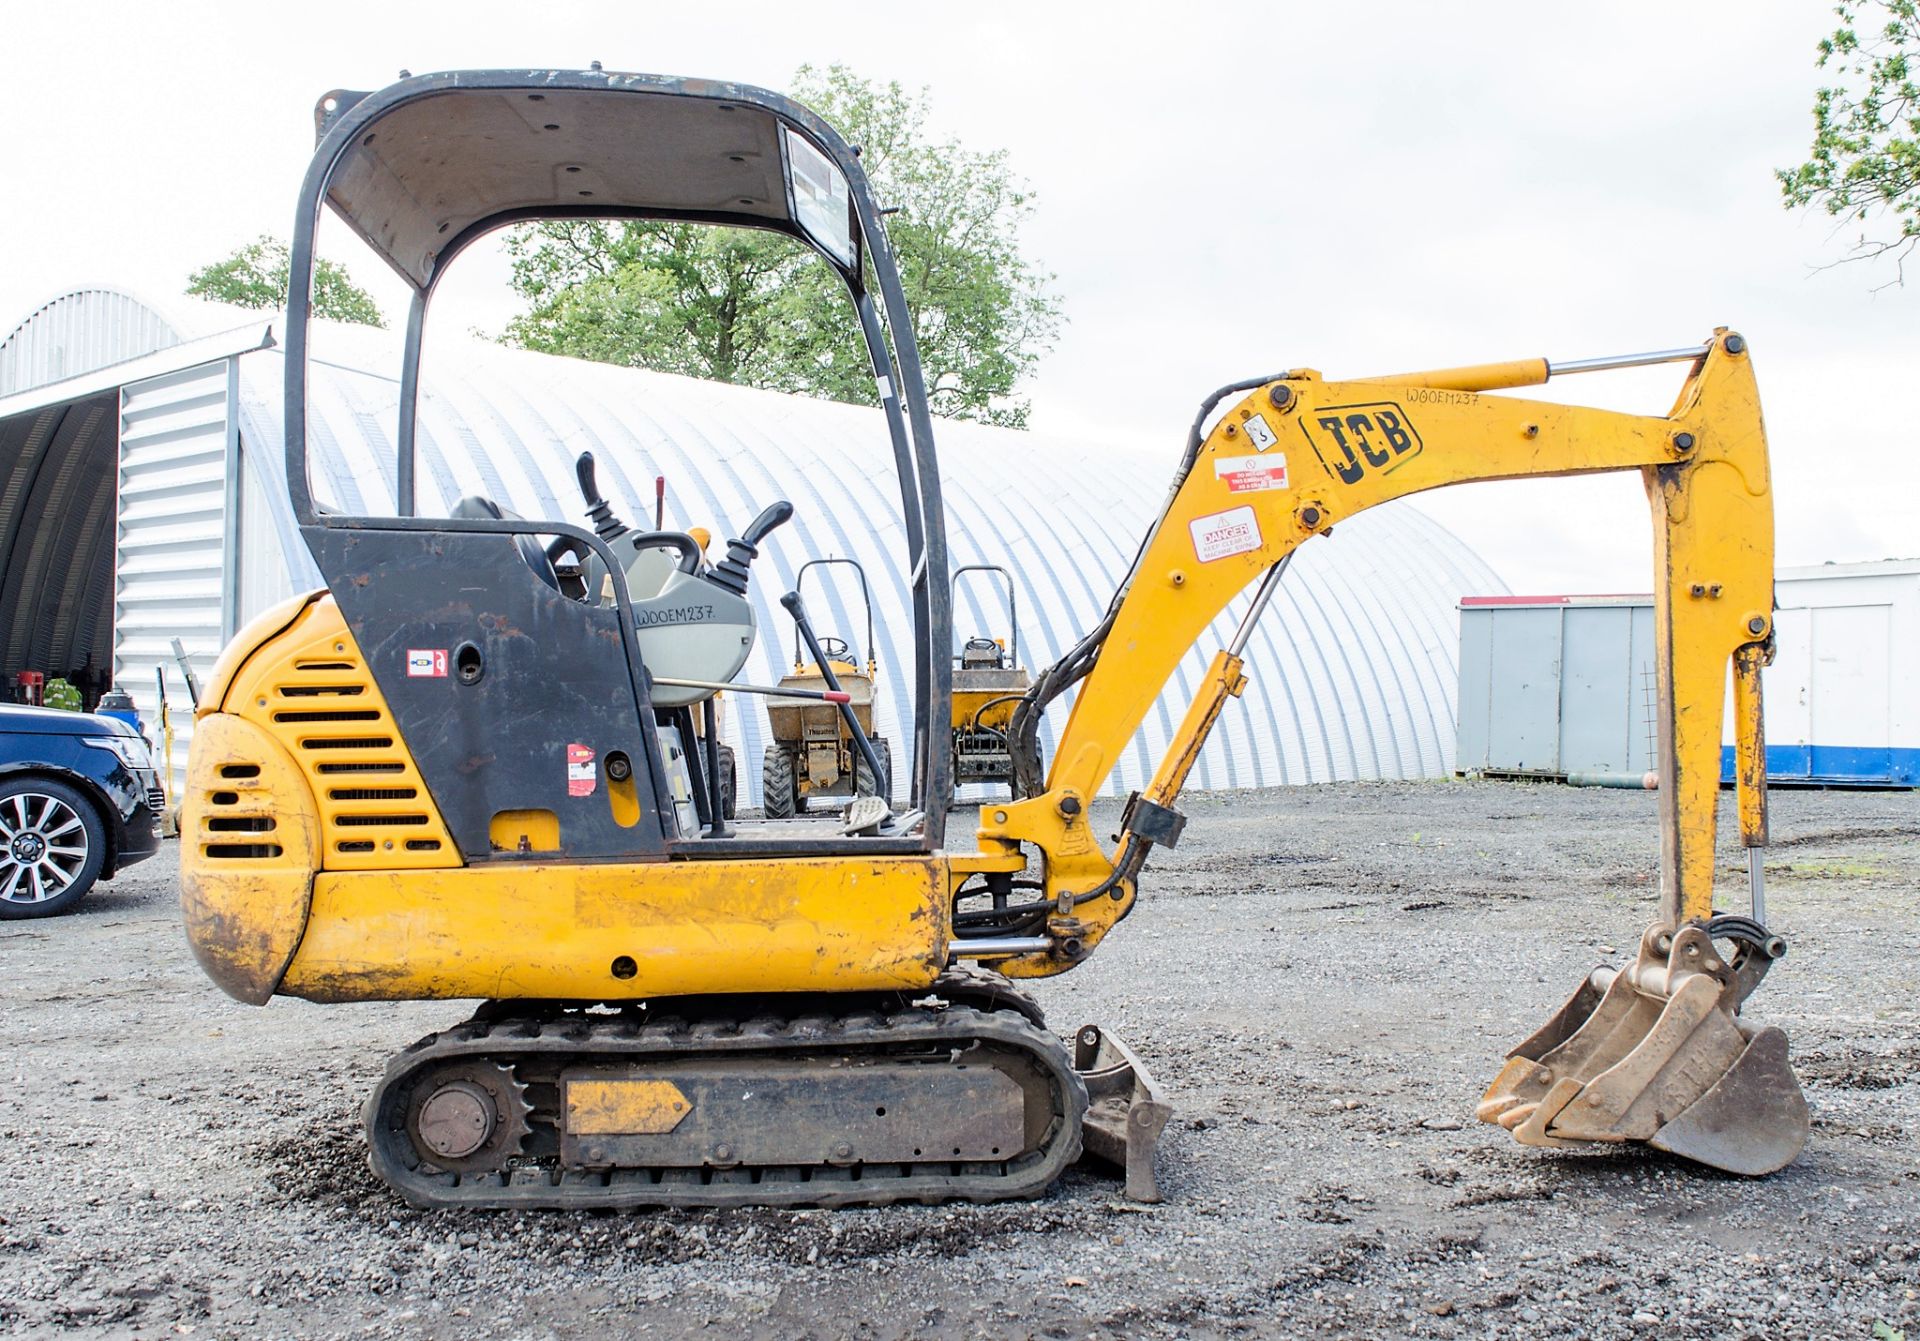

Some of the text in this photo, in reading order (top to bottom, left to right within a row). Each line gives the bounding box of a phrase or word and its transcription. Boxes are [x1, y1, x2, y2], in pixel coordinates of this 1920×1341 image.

[1318, 411, 1411, 485] JCB
[1204, 523, 1249, 544] DANGER
[1203, 543, 1221, 552] KEEP
[1222, 538, 1243, 547] CLEAR
[1204, 547, 1233, 559] MACHINE
